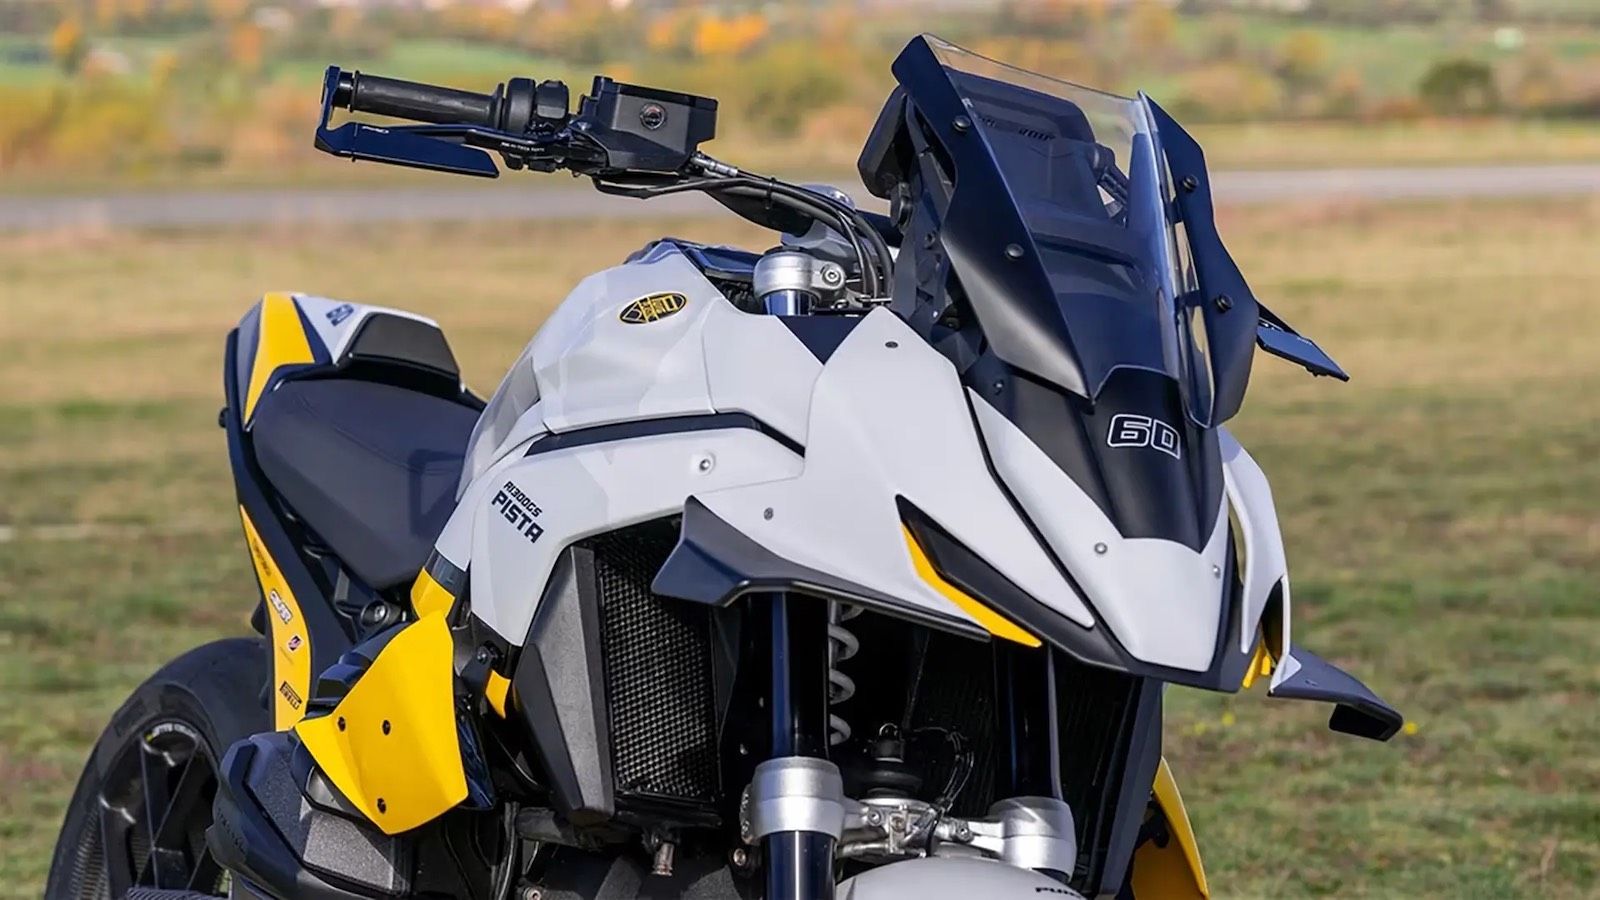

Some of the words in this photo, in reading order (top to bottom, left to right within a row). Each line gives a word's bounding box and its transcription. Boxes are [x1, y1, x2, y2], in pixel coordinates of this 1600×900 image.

[1107, 413, 1181, 460] 60
[491, 490, 545, 544] PISTA
[503, 480, 543, 518] R1300GS
